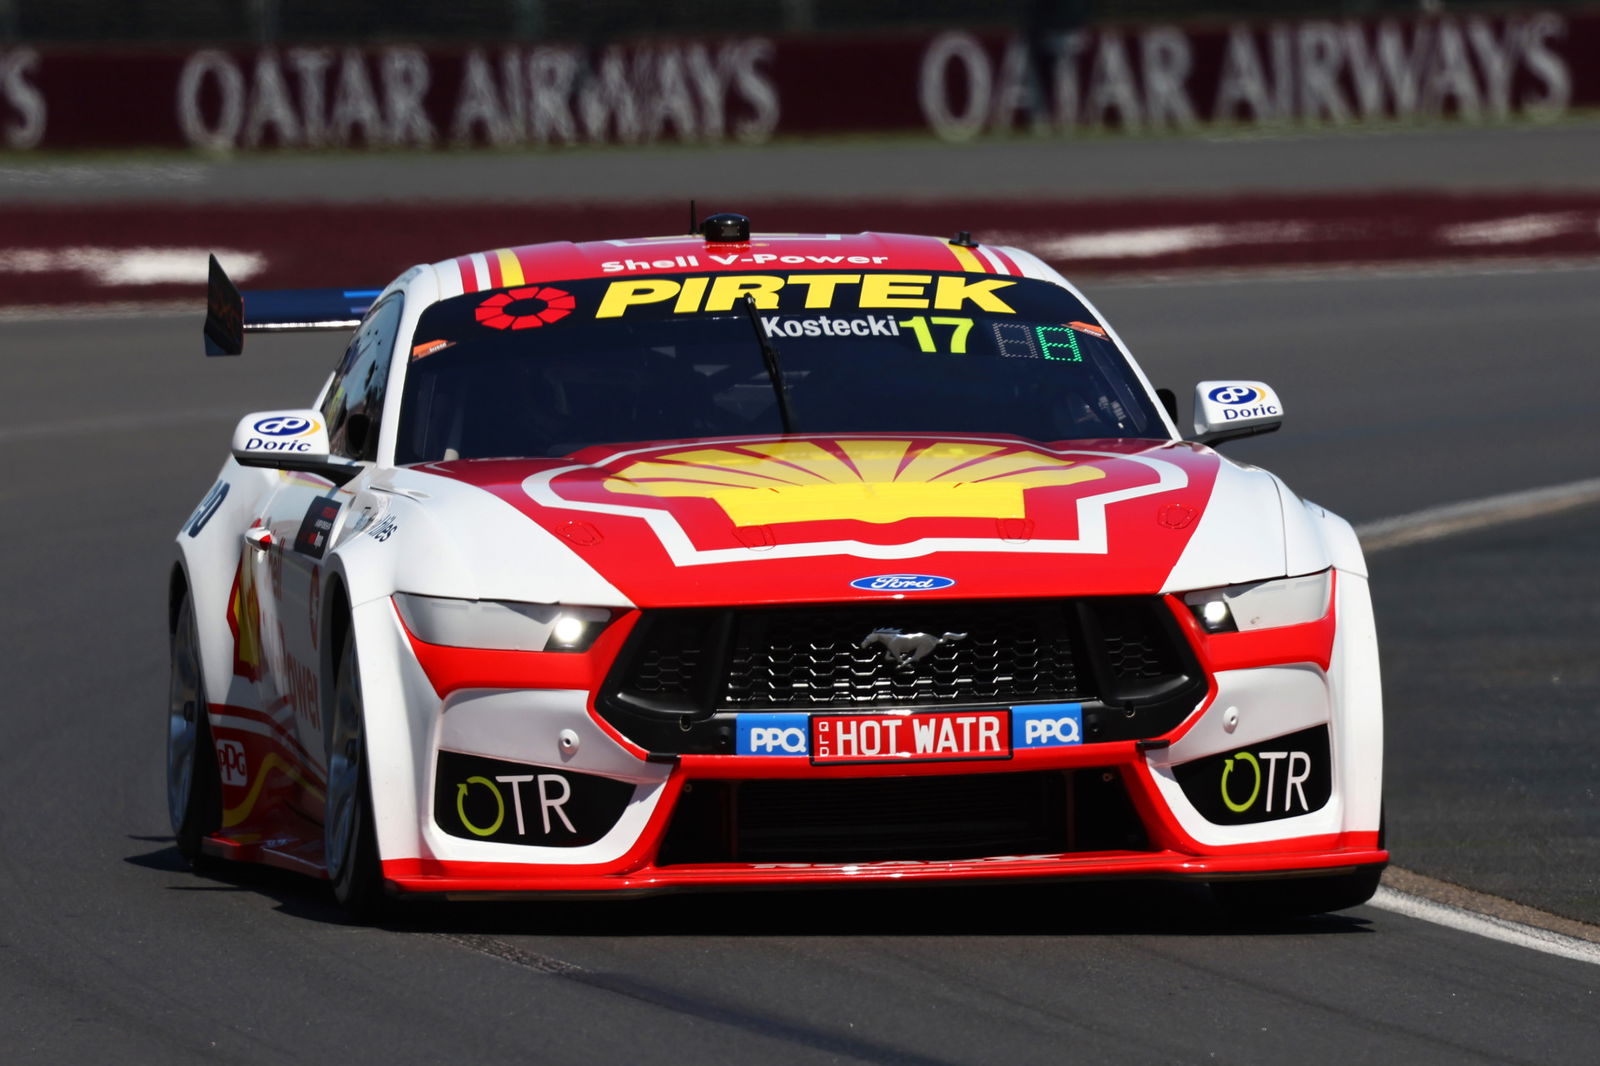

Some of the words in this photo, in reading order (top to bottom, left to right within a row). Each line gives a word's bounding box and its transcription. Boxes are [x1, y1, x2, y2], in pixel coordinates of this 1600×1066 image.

[178, 47, 436, 152] QATAR
[454, 39, 781, 146] AIRWAYS
[920, 28, 1200, 142] QATAR
[1212, 12, 1572, 128] AIRWAYS
[601, 255, 700, 272] Shell
[709, 253, 888, 266] V-Power
[595, 274, 1018, 318] PIRTEK
[761, 315, 899, 338] Kostecki
[899, 316, 974, 353] 17
[1223, 404, 1277, 420] Doric
[245, 437, 312, 452] Doric
[871, 576, 934, 588] Ford
[750, 727, 807, 753] PPQ
[818, 721, 830, 757] QLD
[836, 717, 902, 756] HOT
[913, 715, 1001, 753] WATR
[1025, 717, 1080, 745] PPQ
[1221, 751, 1311, 812] OTR
[456, 774, 577, 836] OTR
